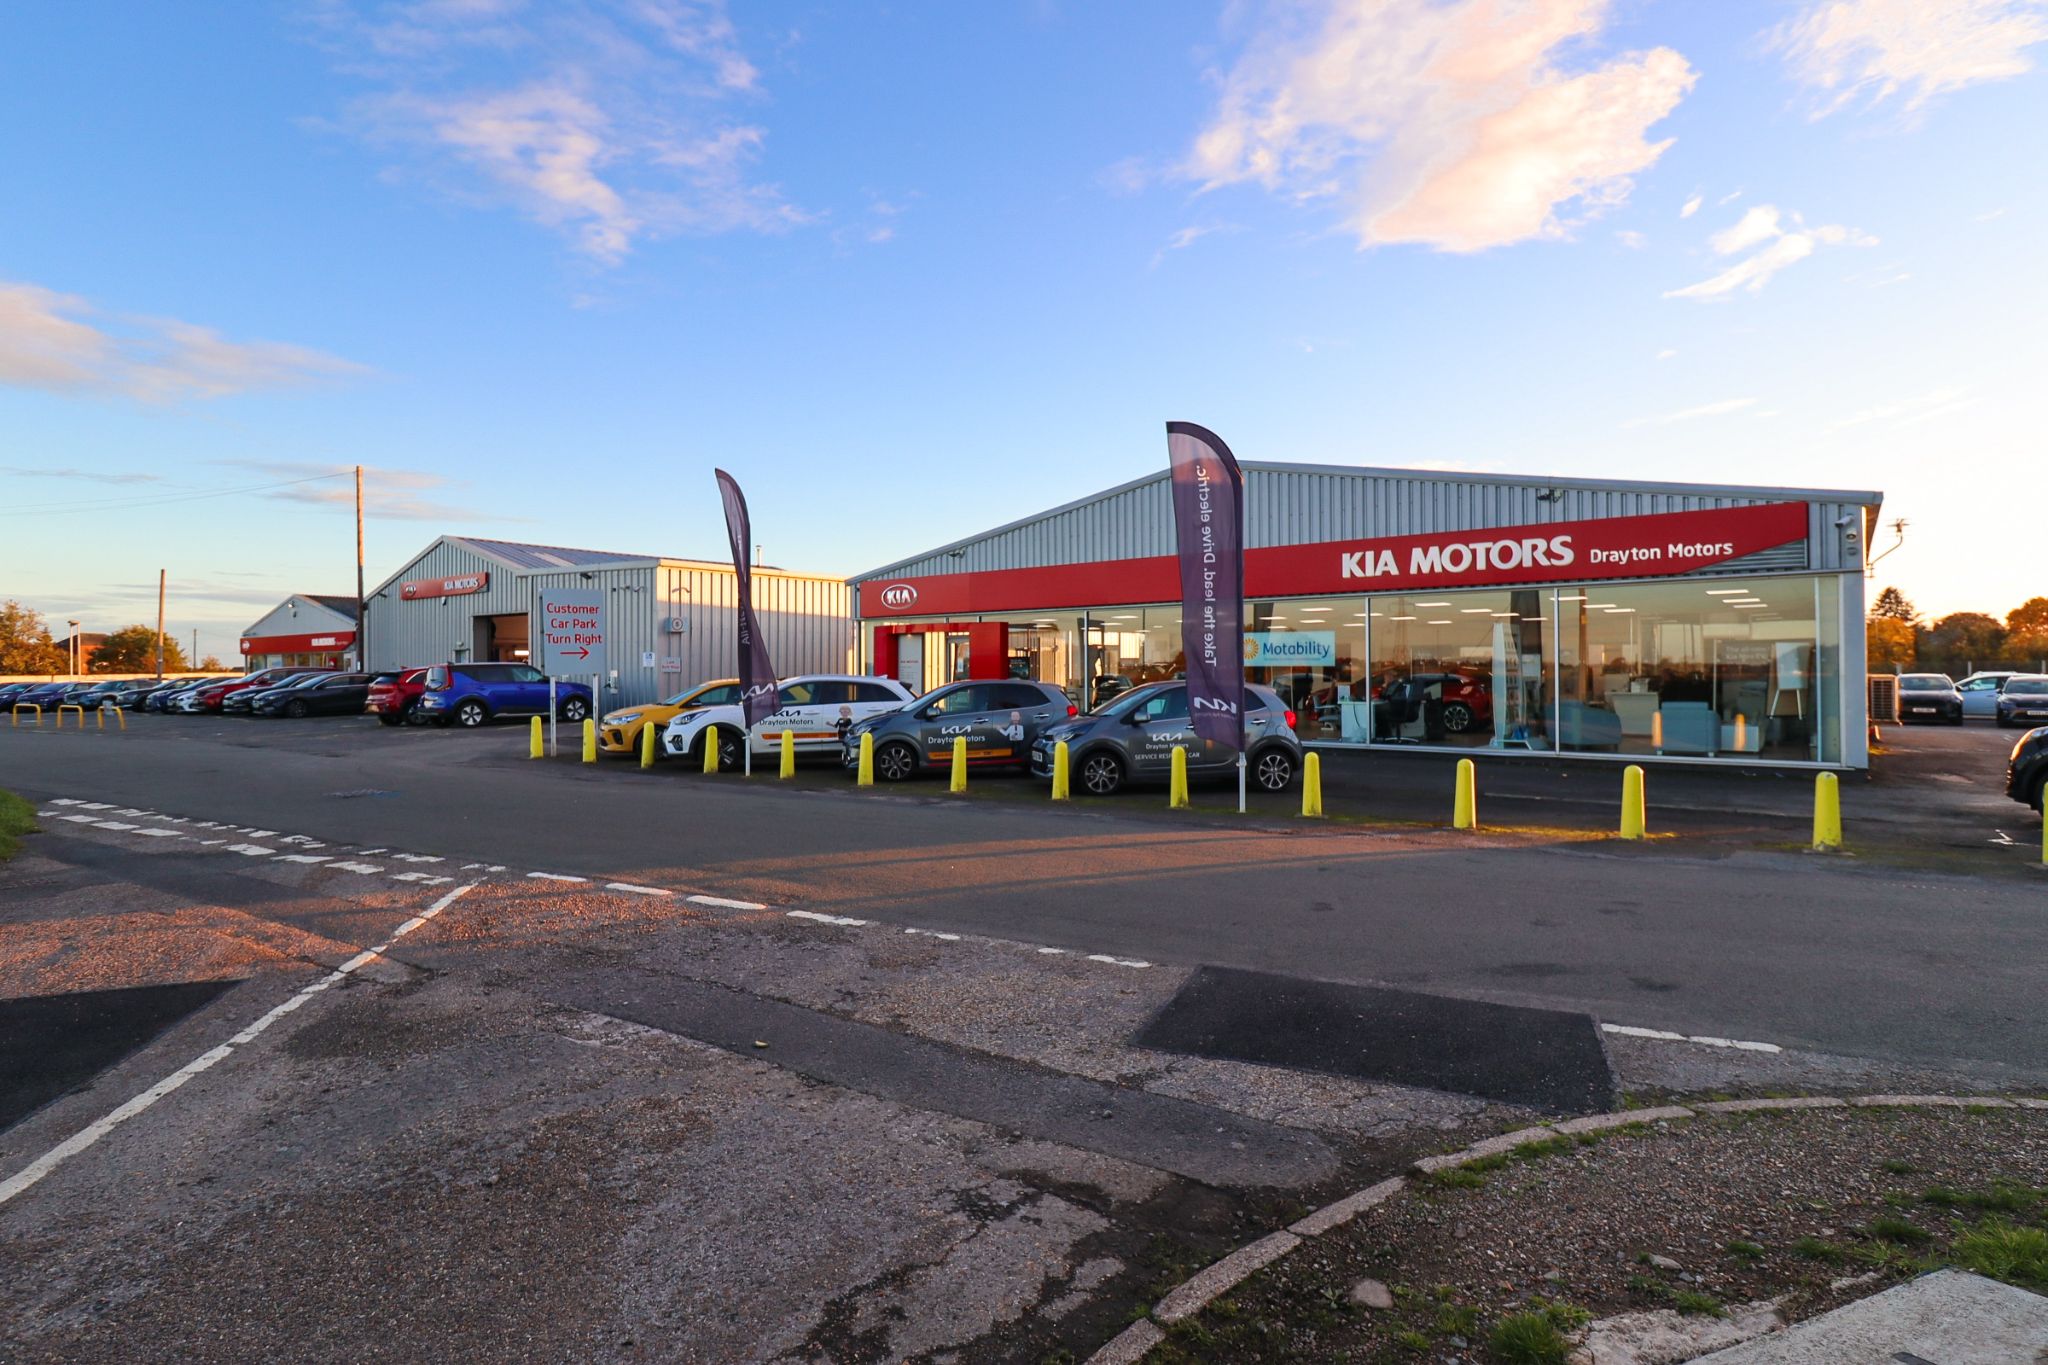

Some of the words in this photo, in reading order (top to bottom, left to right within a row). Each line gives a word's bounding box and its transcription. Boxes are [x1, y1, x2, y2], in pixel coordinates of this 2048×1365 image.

[1340, 548, 1400, 579] KIA
[1409, 535, 1575, 575] MOTORS
[1590, 546, 1662, 565] Drayton
[1667, 541, 1734, 559] Motors
[546, 602, 600, 615] Customer
[550, 618, 569, 629] Car
[573, 618, 597, 629] Park
[545, 633, 571, 644] Turn
[574, 634, 603, 646] Right
[1262, 641, 1330, 658] Motability
[760, 719, 788, 727] Drayton
[927, 736, 954, 745] Drayto
